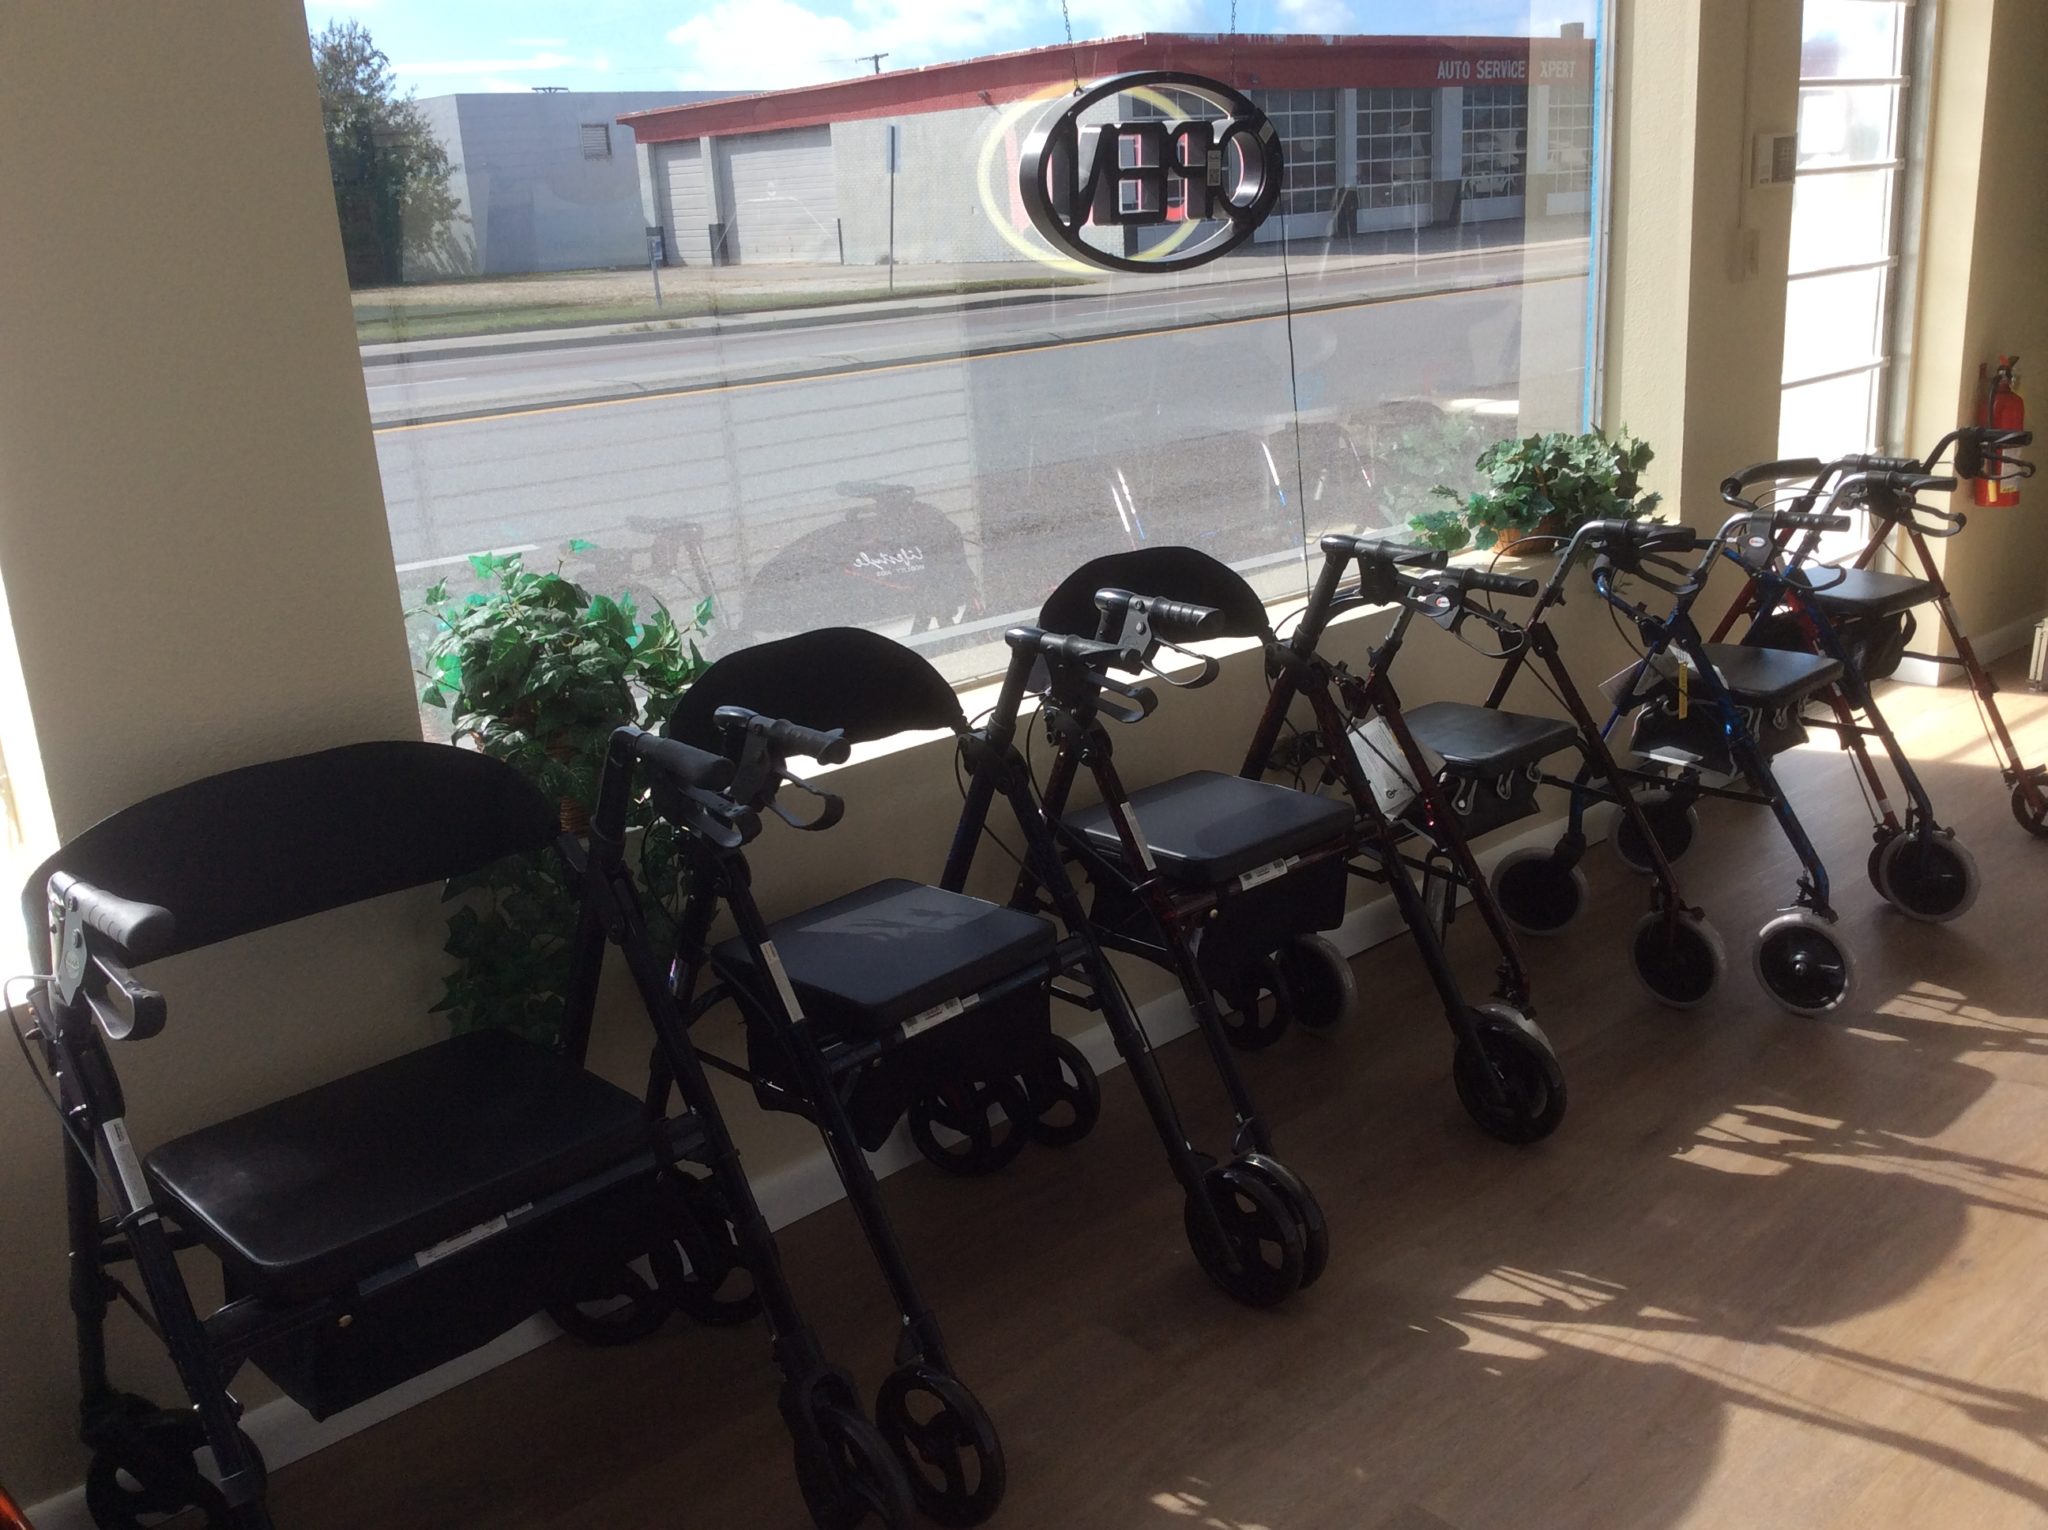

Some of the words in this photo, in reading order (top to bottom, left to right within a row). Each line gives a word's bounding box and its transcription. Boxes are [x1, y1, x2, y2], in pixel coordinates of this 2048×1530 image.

[1437, 60, 1470, 79] AUTO
[1476, 60, 1526, 79] SERVICE
[1540, 61, 1577, 79] XPERT
